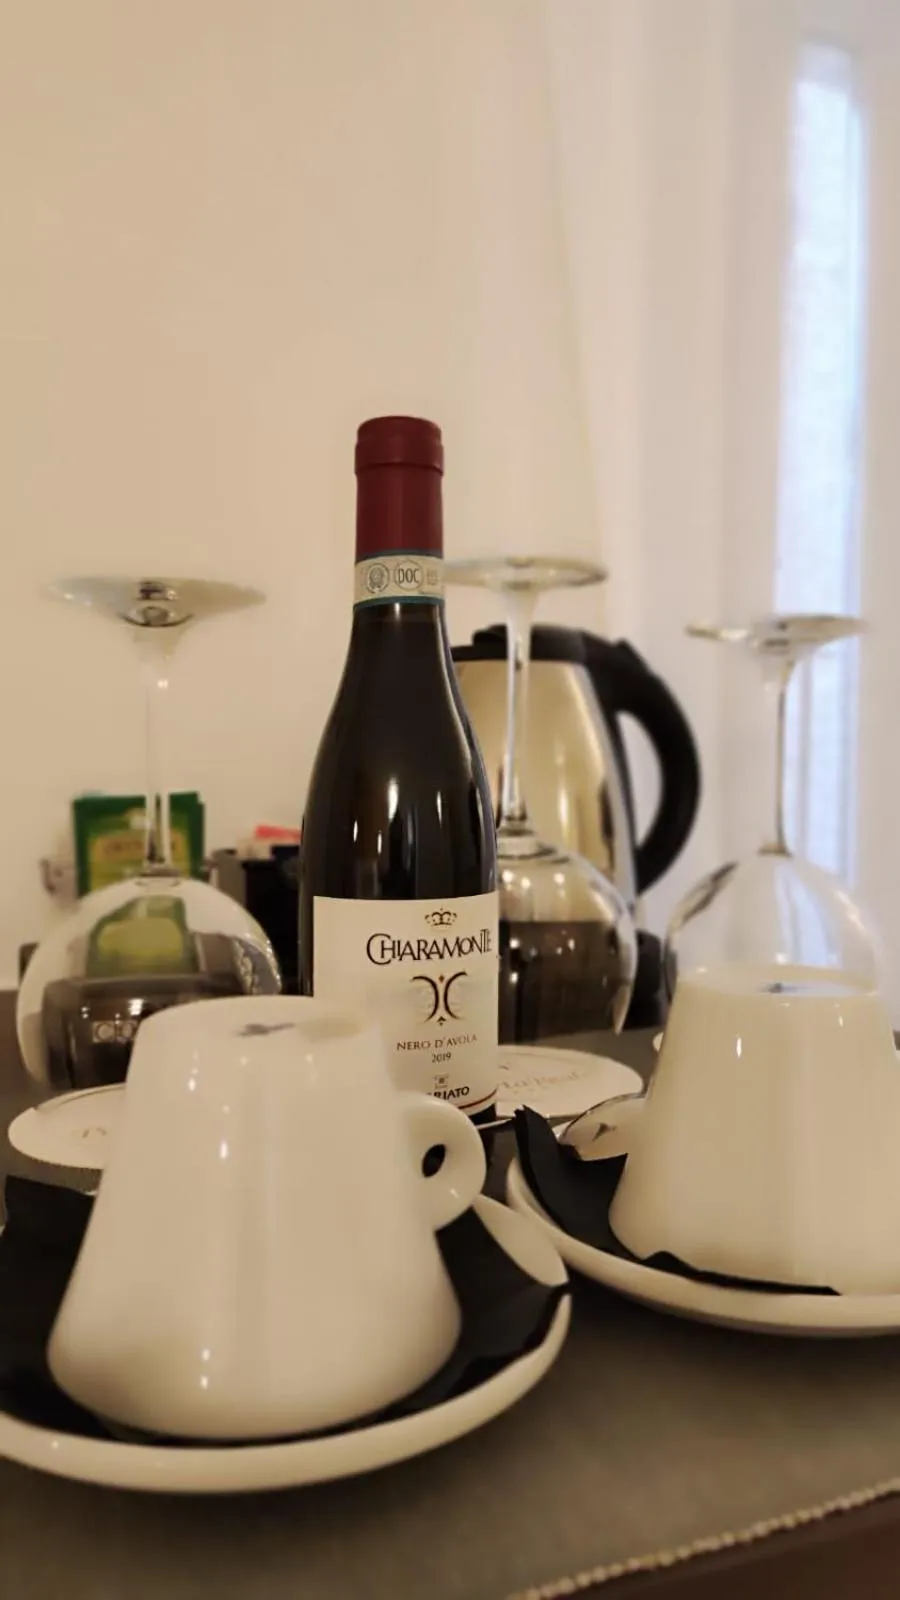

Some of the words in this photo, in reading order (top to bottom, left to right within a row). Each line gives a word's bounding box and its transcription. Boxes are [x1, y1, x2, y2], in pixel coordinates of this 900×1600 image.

[398, 567, 419, 584] DOC
[366, 928, 492, 966] CHIARAMONTE
[396, 1040, 431, 1051] NERO
[431, 1051, 452, 1064] 2019
[427, 1085, 470, 1100] RIATO
